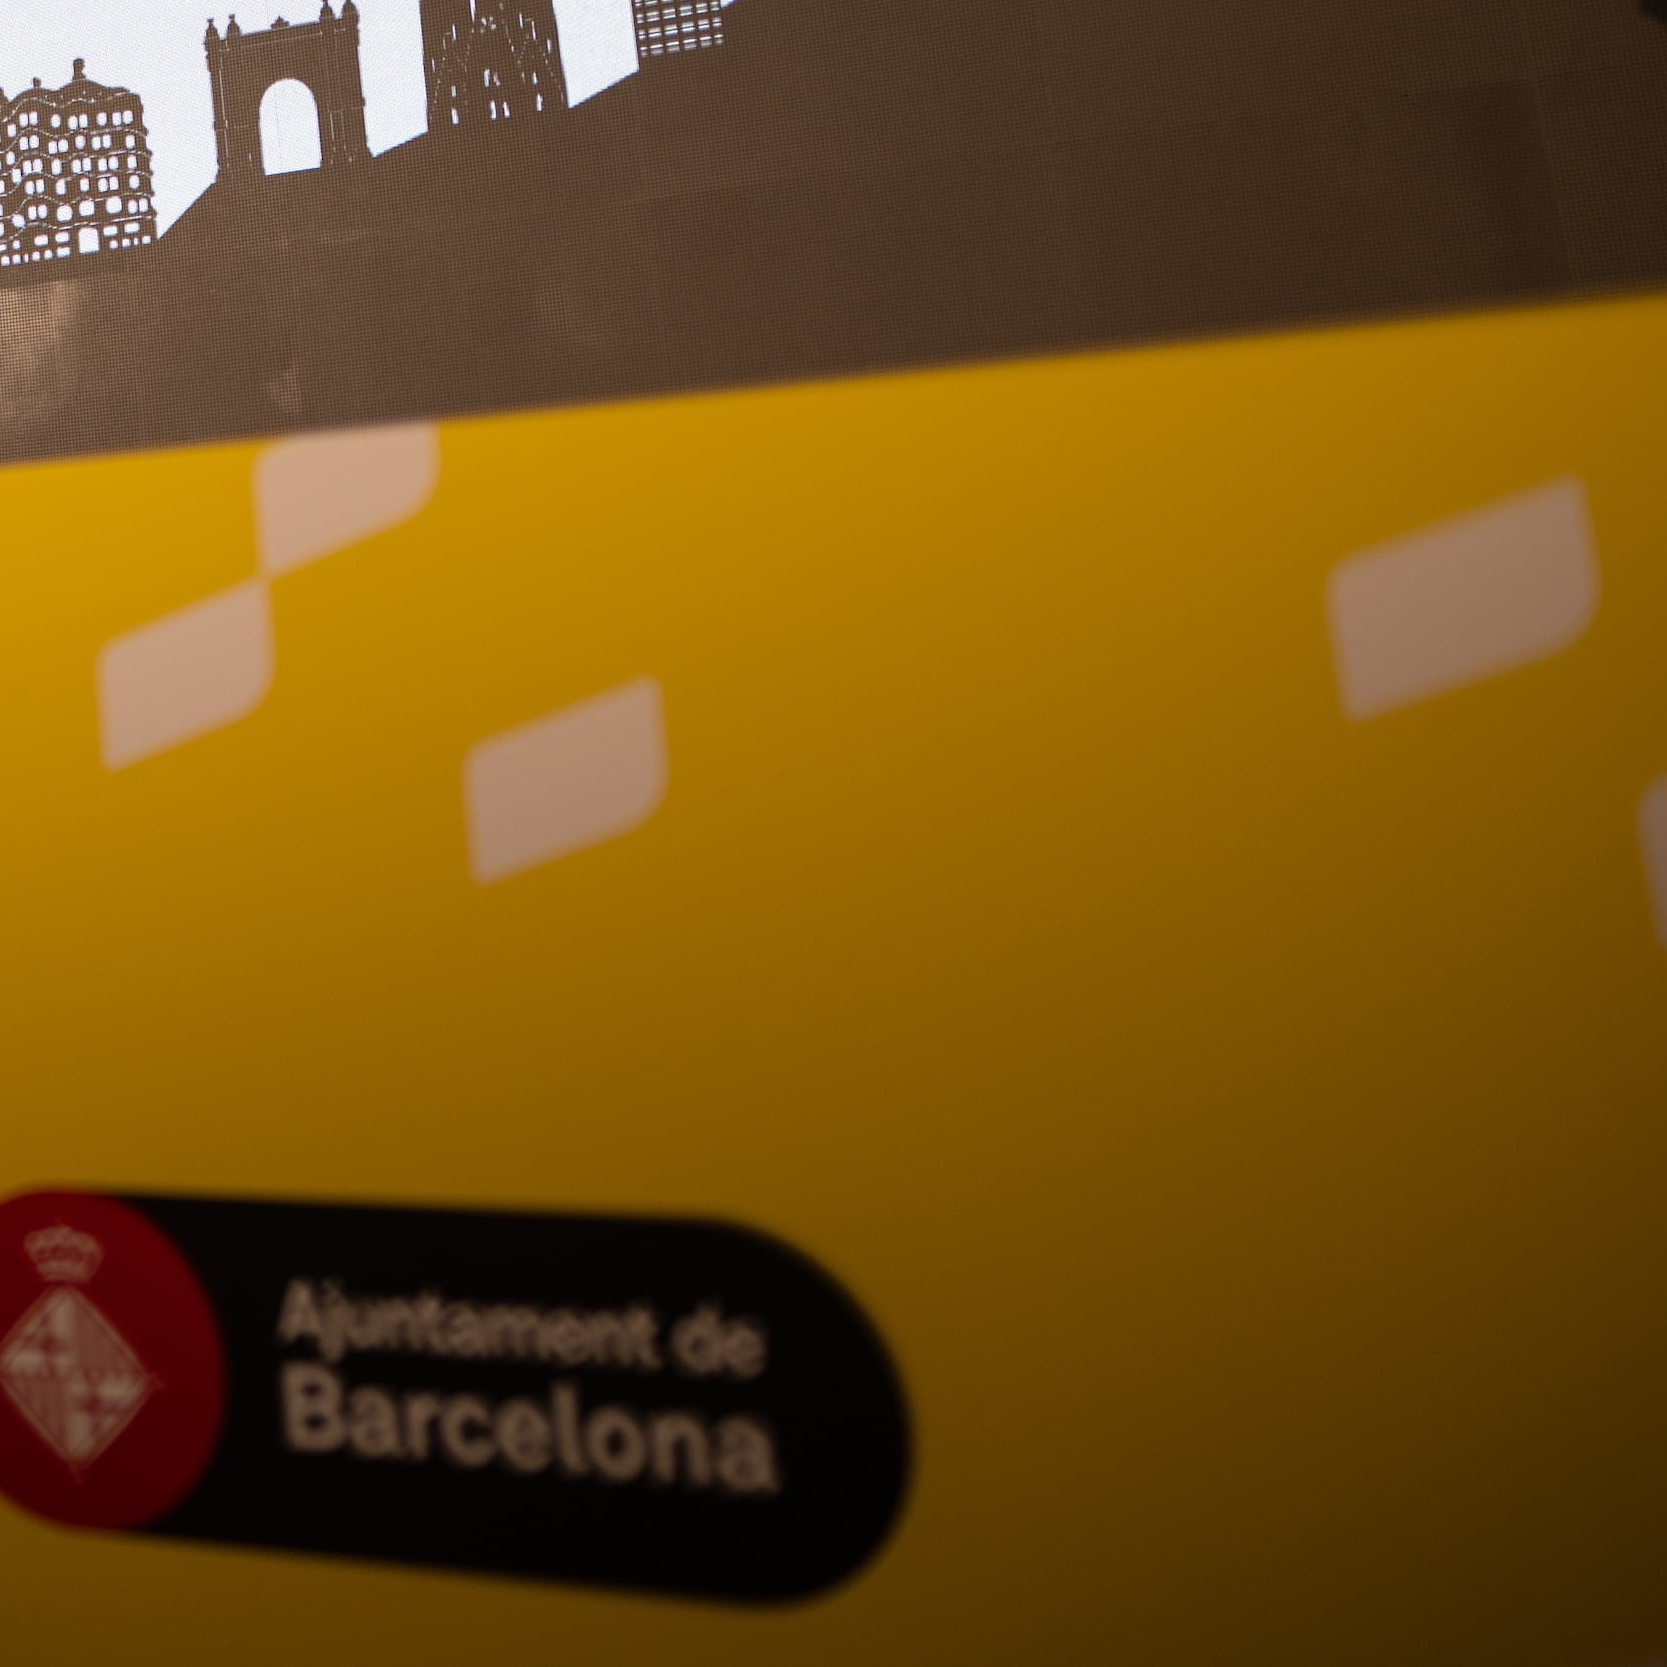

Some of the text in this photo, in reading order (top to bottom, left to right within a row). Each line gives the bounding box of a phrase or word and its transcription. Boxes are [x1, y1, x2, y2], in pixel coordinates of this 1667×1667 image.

[279, 1277, 766, 1377] Ajuntament de
[280, 1362, 779, 1493] Barcelona
